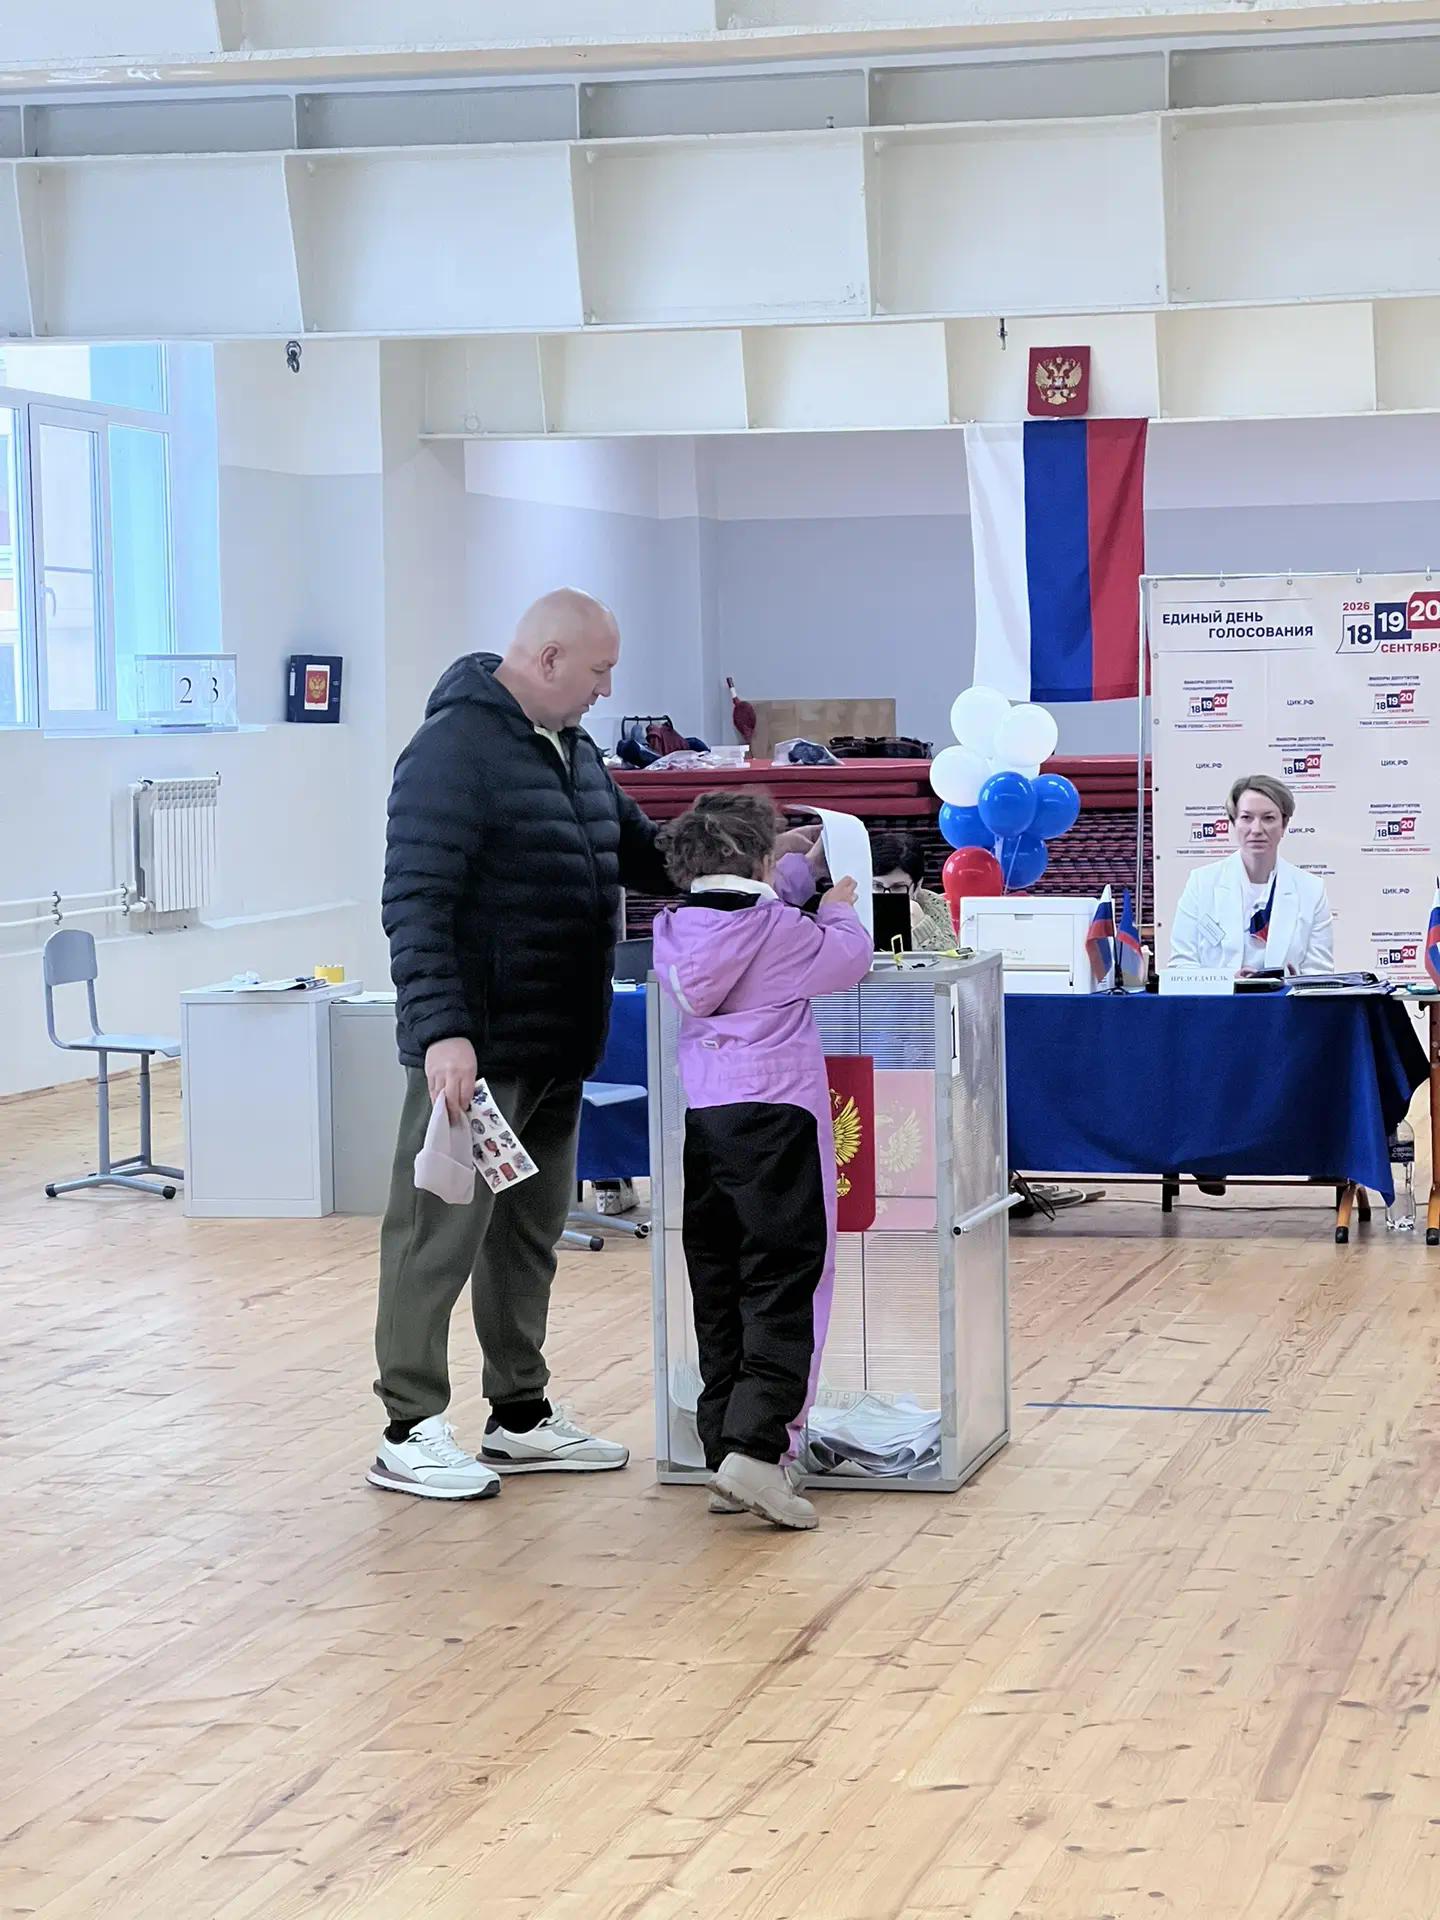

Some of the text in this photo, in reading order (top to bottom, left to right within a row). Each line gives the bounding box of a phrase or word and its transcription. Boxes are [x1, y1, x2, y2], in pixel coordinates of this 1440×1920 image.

[1343, 602, 1370, 611] 2026
[1162, 610, 1263, 625] ЕДИНЫЙ ДЕНЬ
[1347, 600, 1440, 645] 18 19 20
[1209, 626, 1313, 639] ГОЛОСОВАНИЯ
[179, 677, 193, 703] 2
[1191, 705, 1201, 713] 18
[1202, 700, 1213, 709] 19
[1376, 693, 1413, 710] 18 19 20
[1284, 758, 1319, 774] 18 19 20
[1193, 831, 1202, 839] 18
[1204, 826, 1213, 835] 19
[1377, 829, 1387, 837] 18
[1401, 820, 1413, 828] 20
[1380, 957, 1388, 965] 18
[1391, 952, 1401, 961] 19
